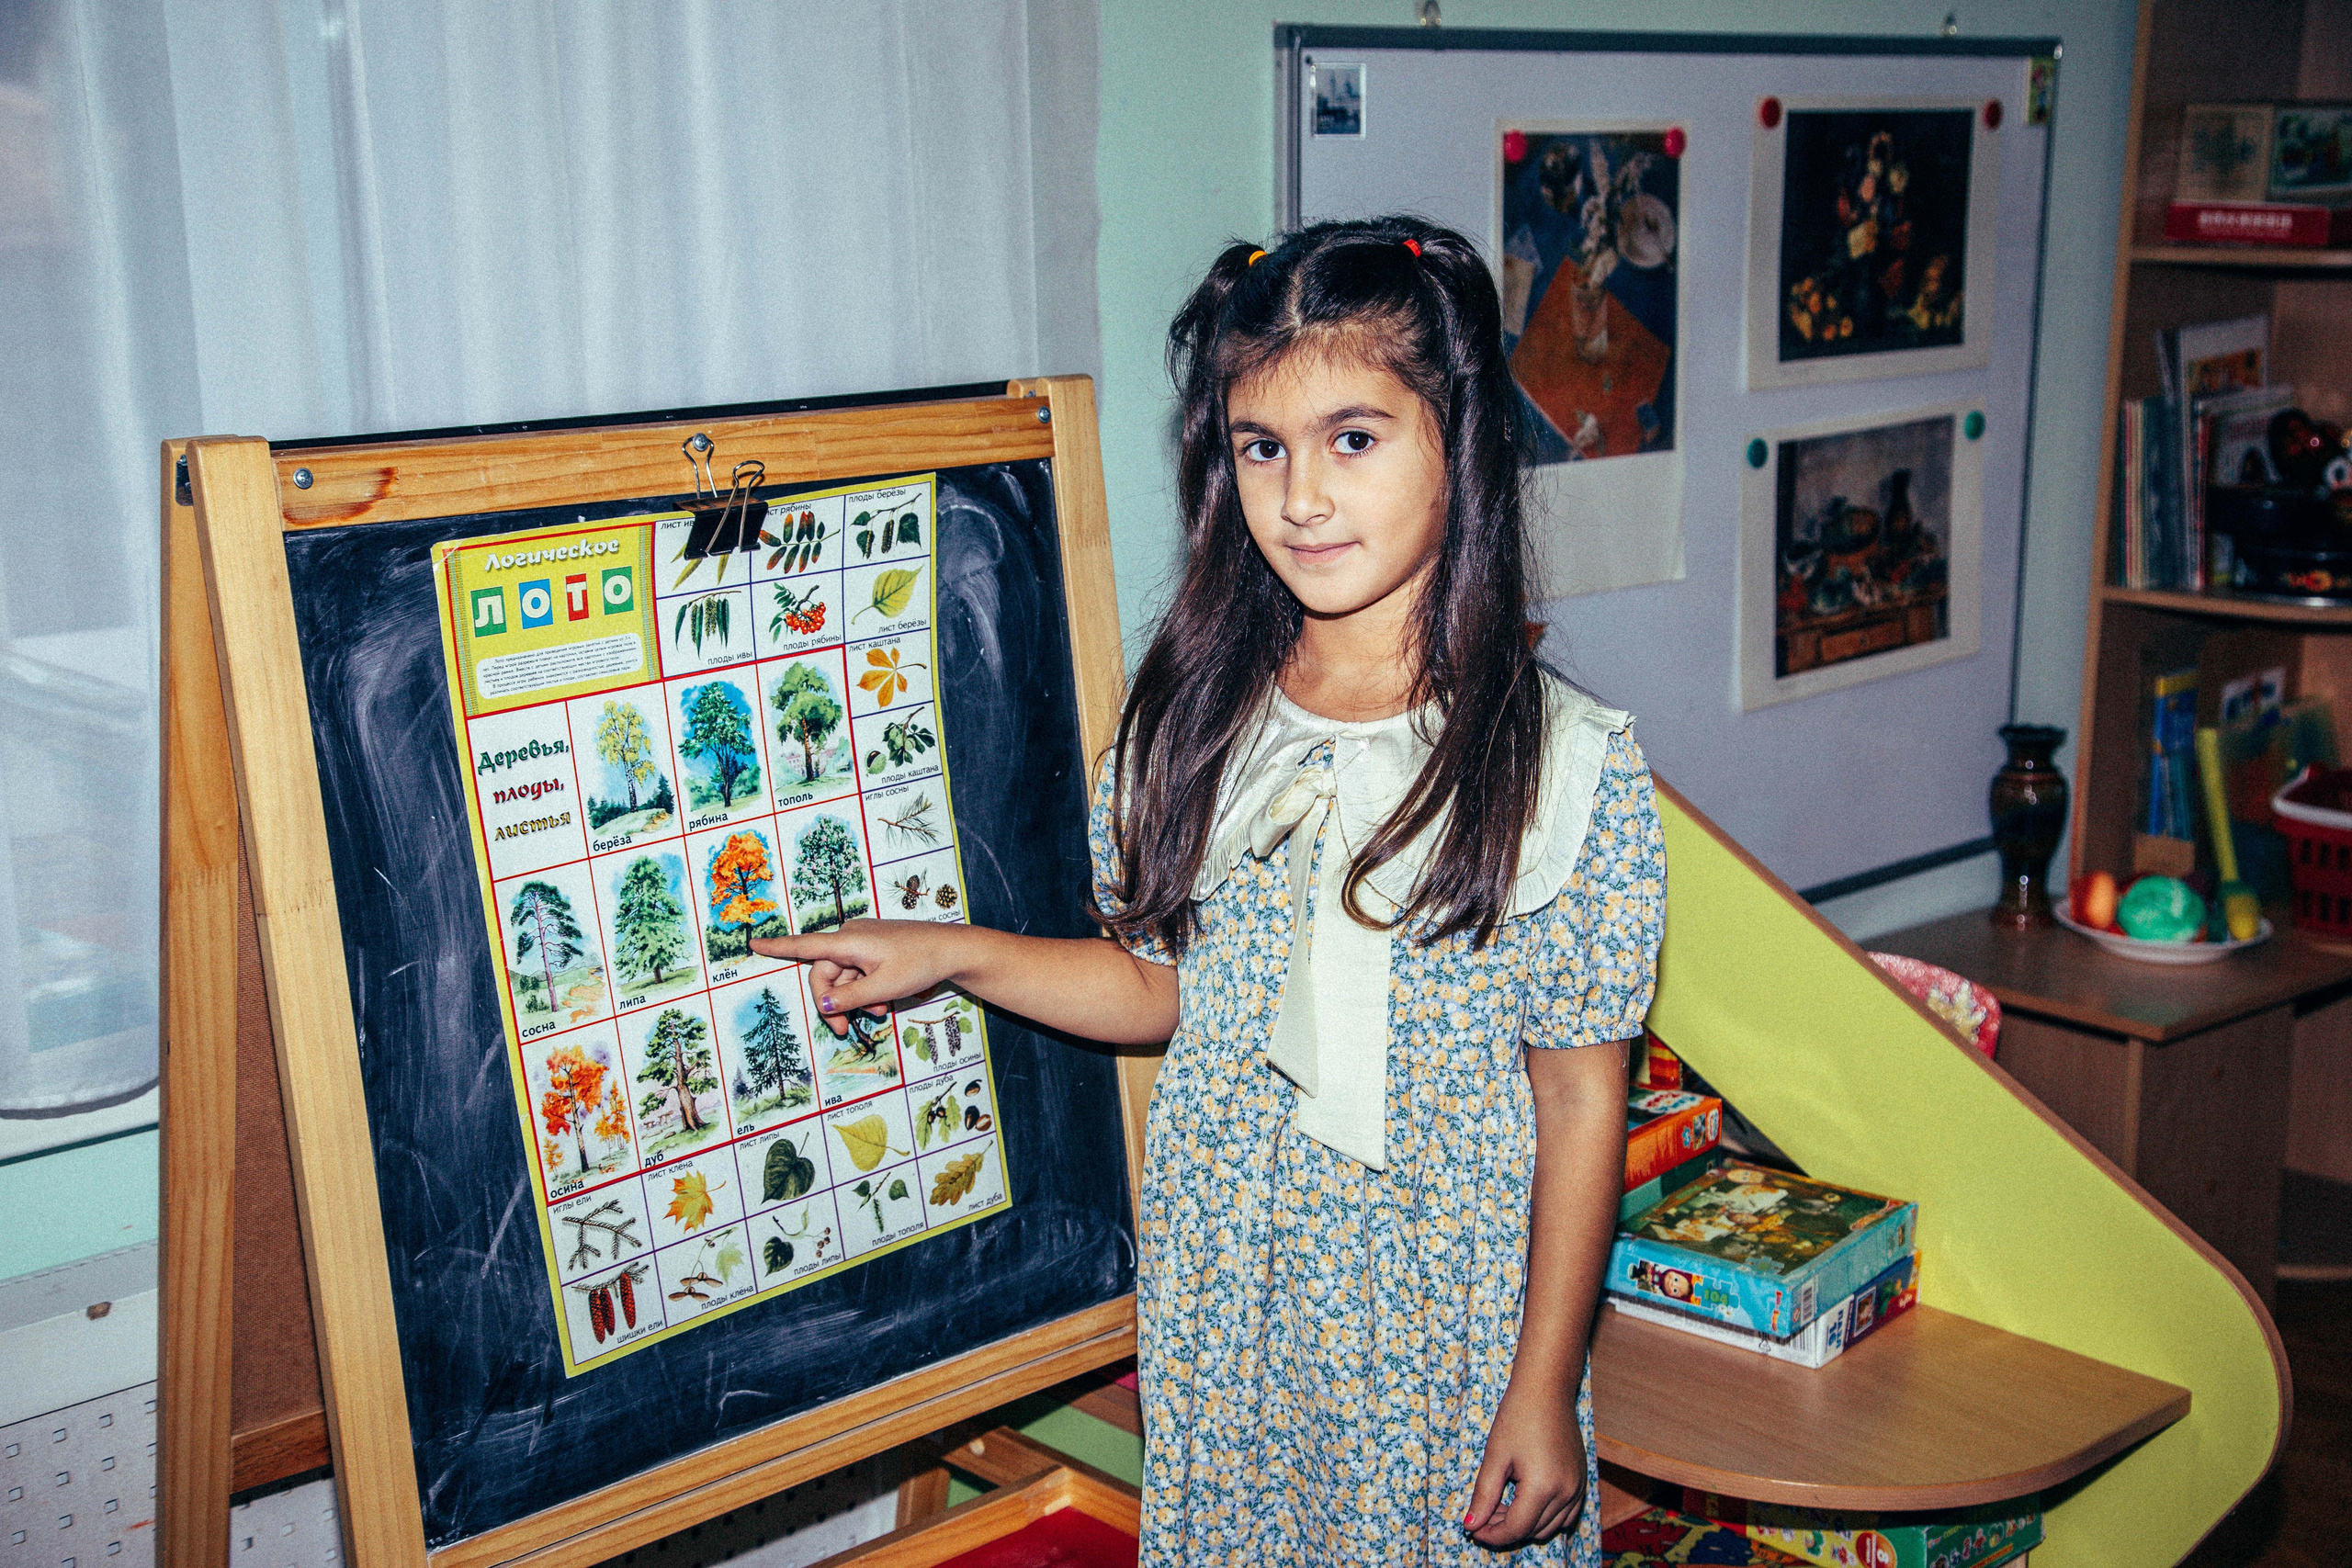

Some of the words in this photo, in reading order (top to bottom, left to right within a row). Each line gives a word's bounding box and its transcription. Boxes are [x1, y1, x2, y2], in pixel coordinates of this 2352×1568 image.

[849, 492, 874, 503] плоды
[876, 487, 906, 500] берёзы
[781, 502, 811, 514] рябины
[661, 521, 682, 530] лист
[483, 538, 620, 571] Логическое
[474, 574, 632, 629] ЛОТО
[878, 625, 896, 634] лист
[898, 617, 927, 630] берёзы
[783, 639, 809, 652] плоды
[812, 634, 842, 647] рябины
[849, 643, 866, 652] лист
[868, 637, 901, 649] каштана
[707, 654, 735, 665] плоды
[737, 652, 753, 660] ивы
[478, 739, 570, 775] Деревья,
[882, 772, 907, 784] плоды
[908, 764, 939, 777] каштана
[492, 778, 564, 805] плоды,
[777, 792, 814, 807] тополь
[865, 792, 884, 802] иглы
[886, 784, 910, 797] сосны
[494, 812, 571, 841] листья
[689, 813, 728, 832] рябина
[593, 834, 632, 852] берёза
[939, 909, 961, 921] сосны
[711, 968, 739, 983] клён
[619, 995, 647, 1010] липа
[522, 1021, 557, 1038] сосна
[933, 1061, 957, 1073] плоды
[959, 1053, 981, 1066] осины
[910, 1081, 933, 1094] плоды
[935, 1073, 954, 1088] дуба
[824, 1095, 842, 1107] ива
[827, 1111, 843, 1122] лист
[845, 1100, 873, 1115] тополя
[737, 1123, 755, 1135] ель
[739, 1140, 757, 1151] лист
[759, 1133, 780, 1145] липы
[645, 1150, 664, 1168] дуб
[648, 1170, 667, 1181] лист
[669, 1159, 694, 1176] клёна
[549, 1179, 584, 1199] осина
[553, 1201, 574, 1214] иглы
[576, 1194, 592, 1206] ели
[968, 1200, 985, 1212] лист
[986, 1192, 1003, 1207] дуба
[872, 1233, 897, 1247] плоды
[898, 1222, 924, 1239] тополя
[794, 1262, 820, 1276] плоды
[821, 1253, 842, 1267] липы
[702, 1295, 728, 1310] плоды
[729, 1284, 754, 1301] клёна
[617, 1326, 646, 1344] шишки
[647, 1319, 663, 1331] ели
[1876, 1549, 1889, 1564] 8
